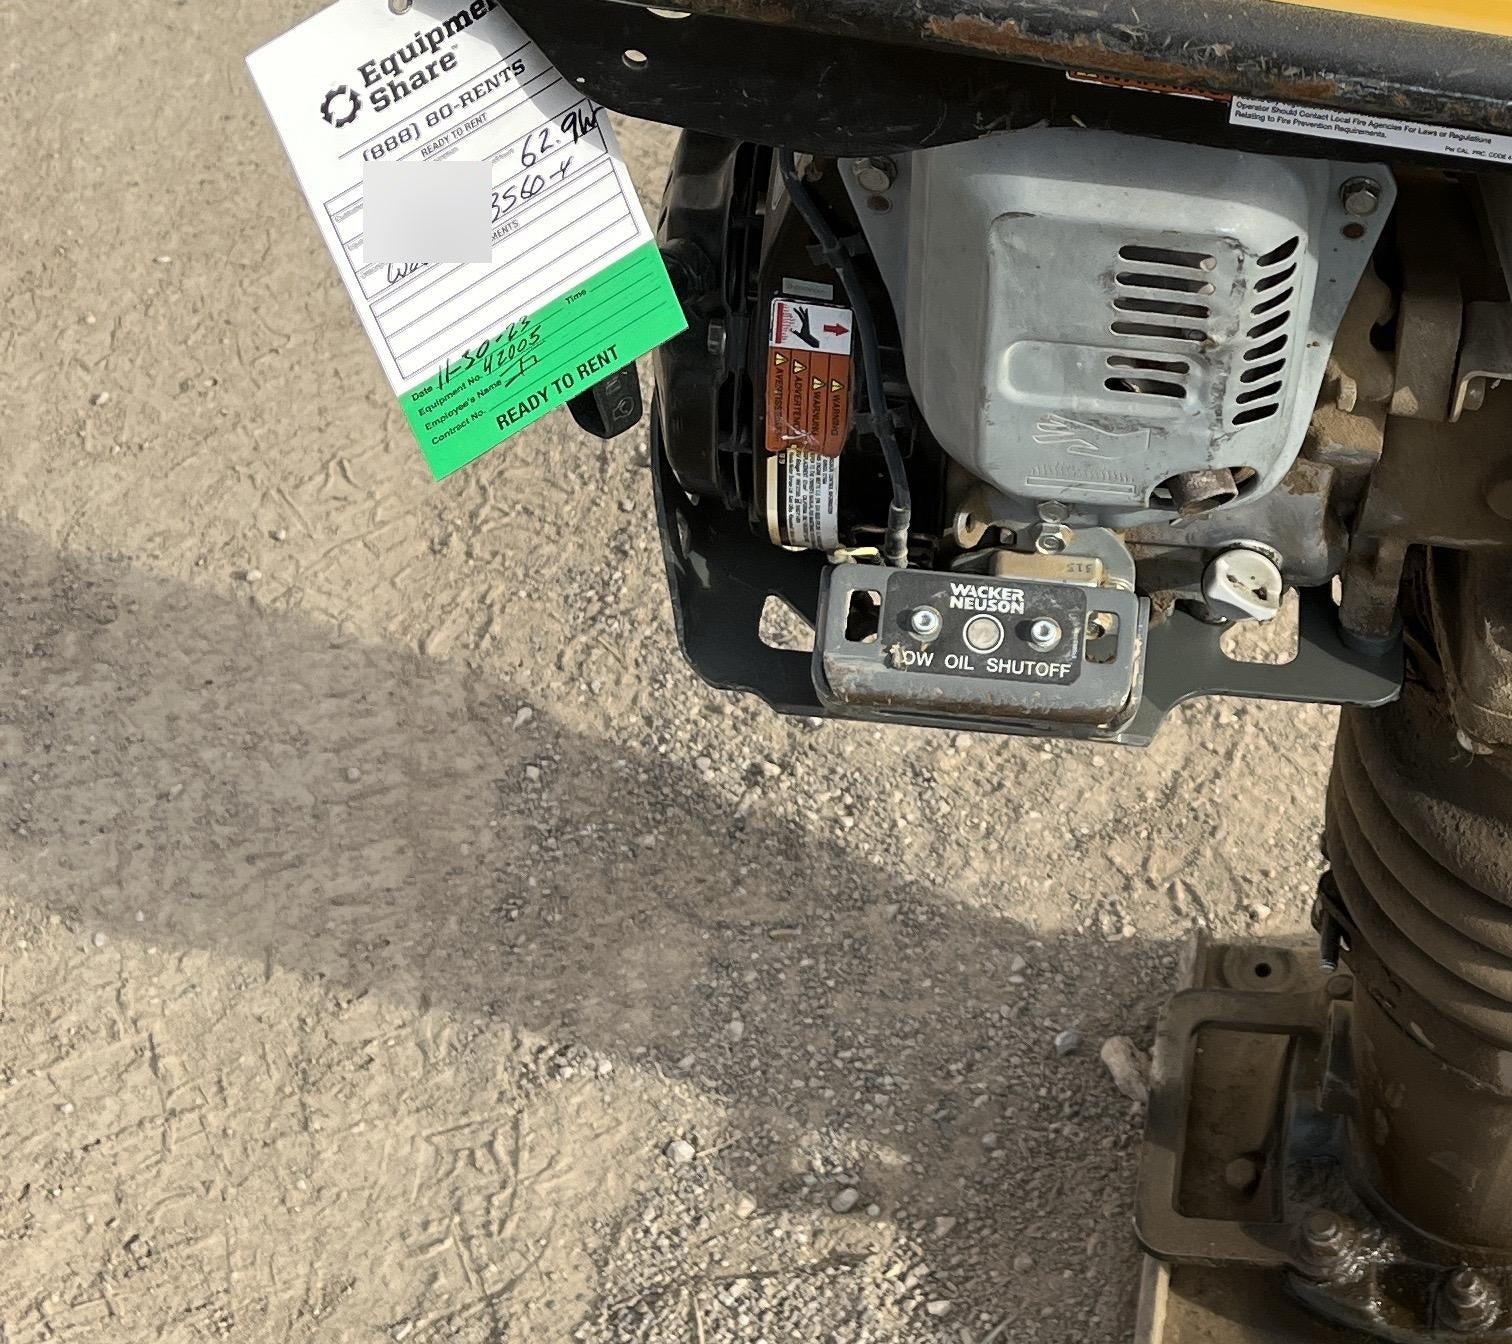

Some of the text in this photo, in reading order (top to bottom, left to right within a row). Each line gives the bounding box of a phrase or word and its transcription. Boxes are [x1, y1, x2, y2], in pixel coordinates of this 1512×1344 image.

[426, 58, 527, 128] 80-RENTS
[420, 135, 450, 158] READY
[451, 126, 464, 140] TO
[464, 112, 488, 133] RENT
[1235, 110, 1387, 139] Relating to Fire Prevention Requirements.
[1271, 106, 1297, 117] Should
[1299, 110, 1329, 121] Contact
[1330, 114, 1351, 124] Local
[1352, 117, 1367, 126] Fire
[1368, 120, 1402, 132] Agencies
[1404, 125, 1417, 133] For
[1418, 127, 1437, 137] Laws
[1449, 131, 1492, 145] Regulations
[411, 385, 434, 402] Date
[418, 380, 467, 417] Equipment
[424, 380, 502, 431] Employee's Name
[496, 386, 550, 431] READY
[551, 374, 574, 395] TO
[575, 344, 620, 381] RENT
[431, 409, 487, 446] Contract No.
[830, 394, 841, 437] WARNING
[949, 582, 1025, 602] WACKER
[949, 595, 1025, 615] NEUSON
[902, 650, 1072, 679] OW OIL SHUTOFF
